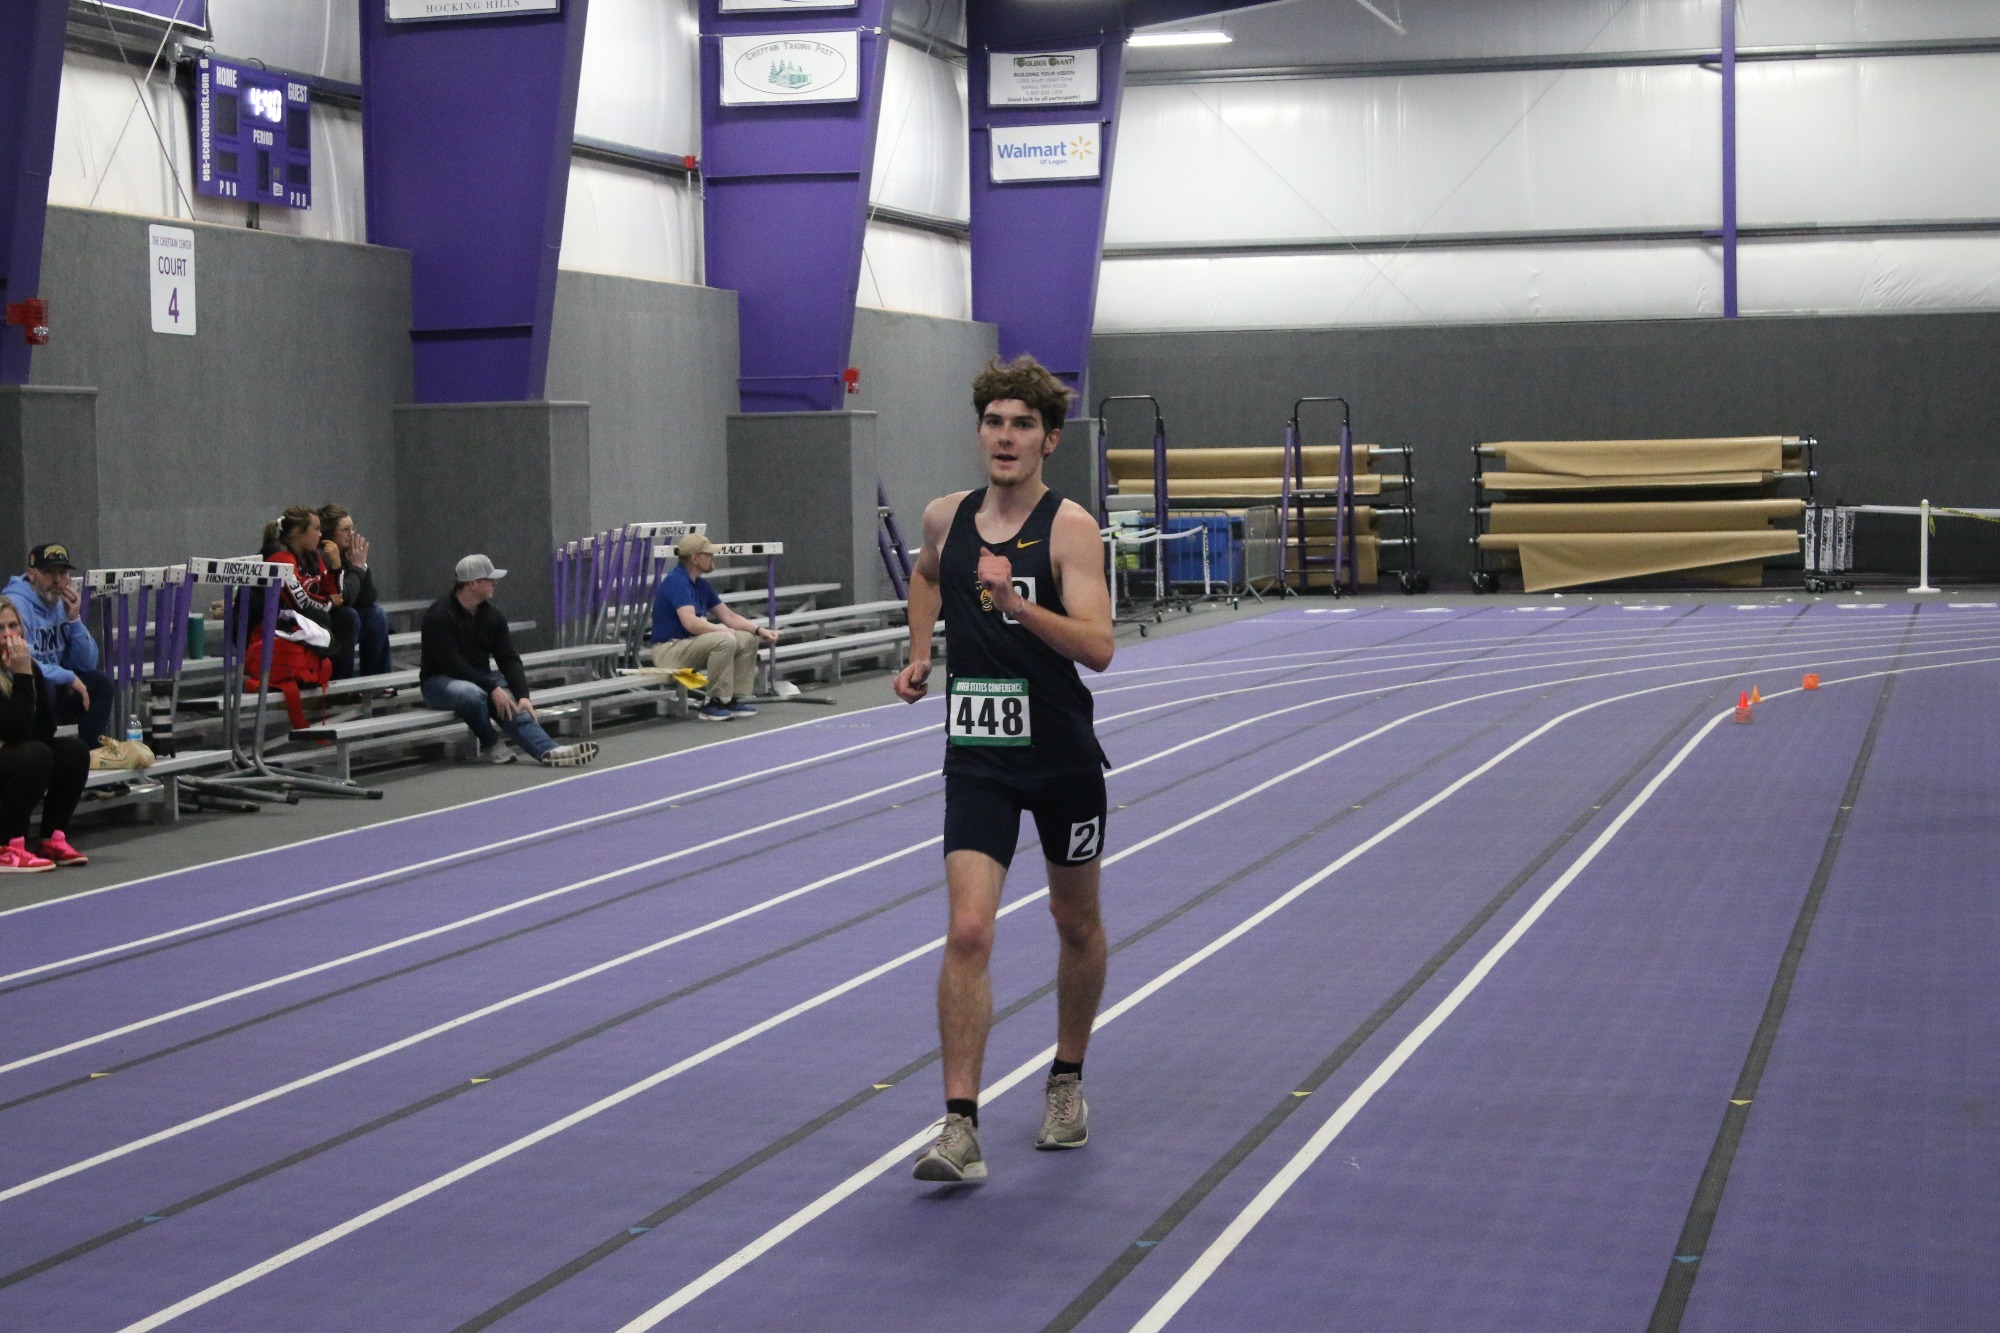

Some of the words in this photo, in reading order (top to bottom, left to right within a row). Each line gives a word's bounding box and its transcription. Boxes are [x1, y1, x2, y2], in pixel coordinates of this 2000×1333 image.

[426, 3, 481, 13] HOCKING
[486, 0, 520, 9] HILLS
[815, 44, 834, 57] POST
[216, 66, 238, 88] HOME
[288, 82, 308, 103] GUEST
[200, 73, 211, 182] oes-scoreboards.com
[253, 129, 274, 146] PERIOD
[996, 141, 1067, 159] Walmart
[158, 256, 187, 277] COURT
[168, 287, 180, 324] 4
[970, 682, 987, 693] STATES
[988, 683, 1023, 693] CONFERENCE
[956, 696, 1024, 736] 448
[1071, 823, 1096, 859] 2
